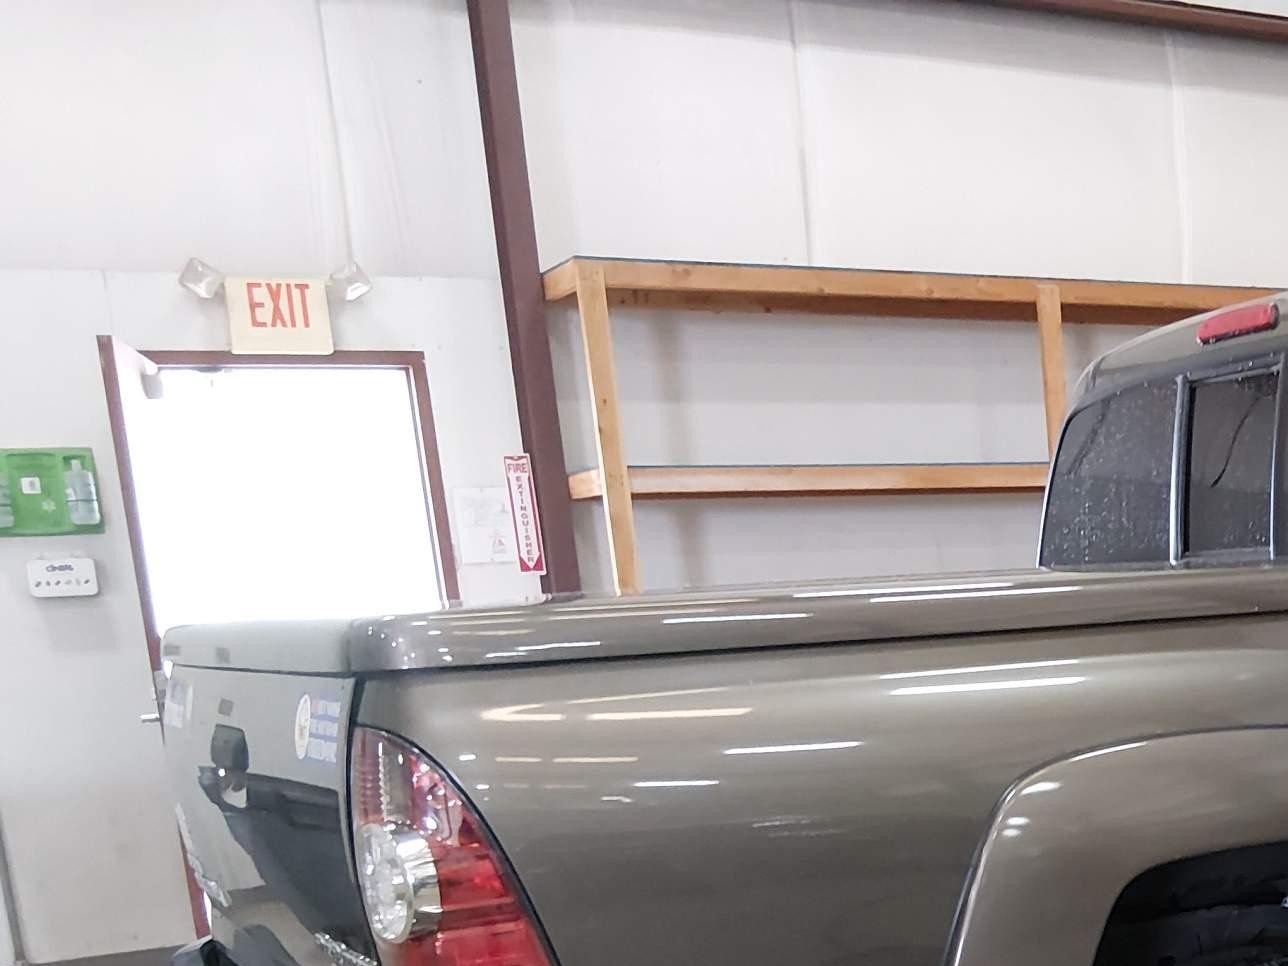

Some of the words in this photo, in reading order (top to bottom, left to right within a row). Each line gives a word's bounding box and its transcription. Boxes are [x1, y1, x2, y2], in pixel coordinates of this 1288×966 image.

[246, 282, 310, 328] EXIT
[507, 462, 529, 474] FIRE
[515, 475, 535, 563] EXTINGUISHER
